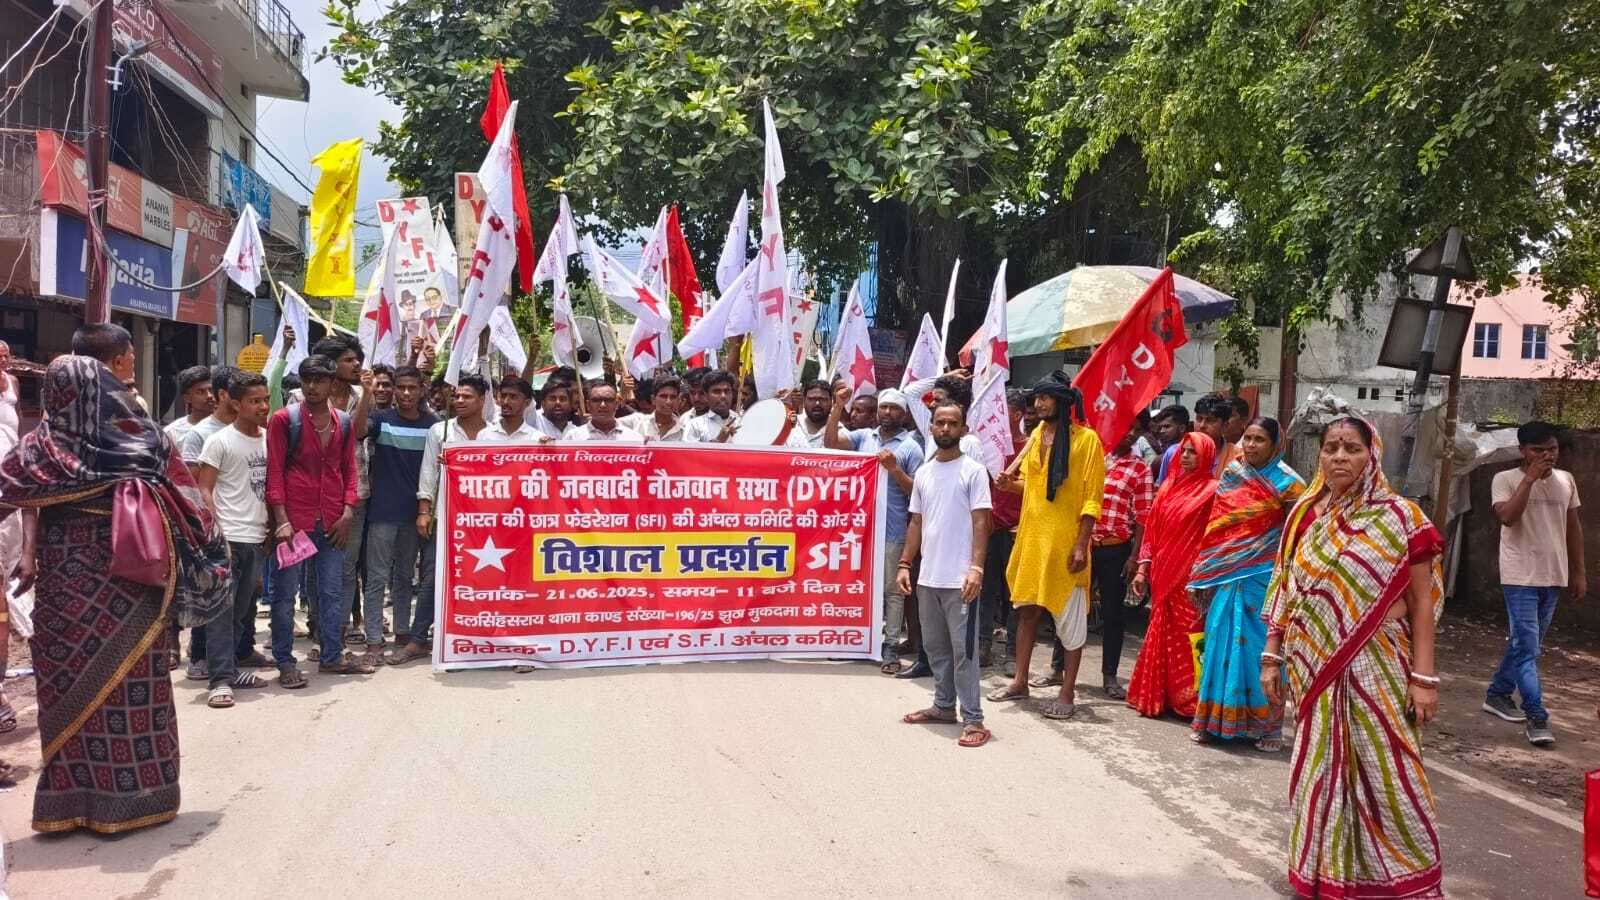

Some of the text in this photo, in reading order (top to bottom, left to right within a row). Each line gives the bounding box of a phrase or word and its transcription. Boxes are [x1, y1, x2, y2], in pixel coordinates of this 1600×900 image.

[107, 174, 122, 202] GL
[145, 198, 170, 216] ANANYA
[144, 213, 171, 231] MARBLES
[202, 218, 219, 241] AGL
[458, 475, 512, 500] भारत
[519, 469, 551, 500] की
[647, 468, 730, 500] नौजवान
[736, 477, 779, 501] सभा
[787, 475, 866, 507] (DYFI)
[456, 508, 867, 530] भारत की छात्र फेडरेशन (SFI) की अंचल कमिटि की ओर से
[453, 530, 465, 577] DYFI
[540, 537, 790, 574] विशाल प्रदर्शन
[806, 541, 862, 571] SFI
[736, 586, 754, 598] 11
[761, 580, 797, 595] बजे
[802, 579, 841, 594] दिन
[846, 580, 866, 594] से
[548, 612, 581, 625] थाना
[585, 611, 624, 624] काण्ड
[747, 606, 800, 622] मुकदमा
[803, 603, 818, 617] के
[560, 637, 632, 655] D.Y.F.I
[639, 632, 675, 651] एवं
[677, 632, 725, 649] S.F.I
[731, 631, 791, 646] अंचल
[794, 630, 864, 645] कमिटि
